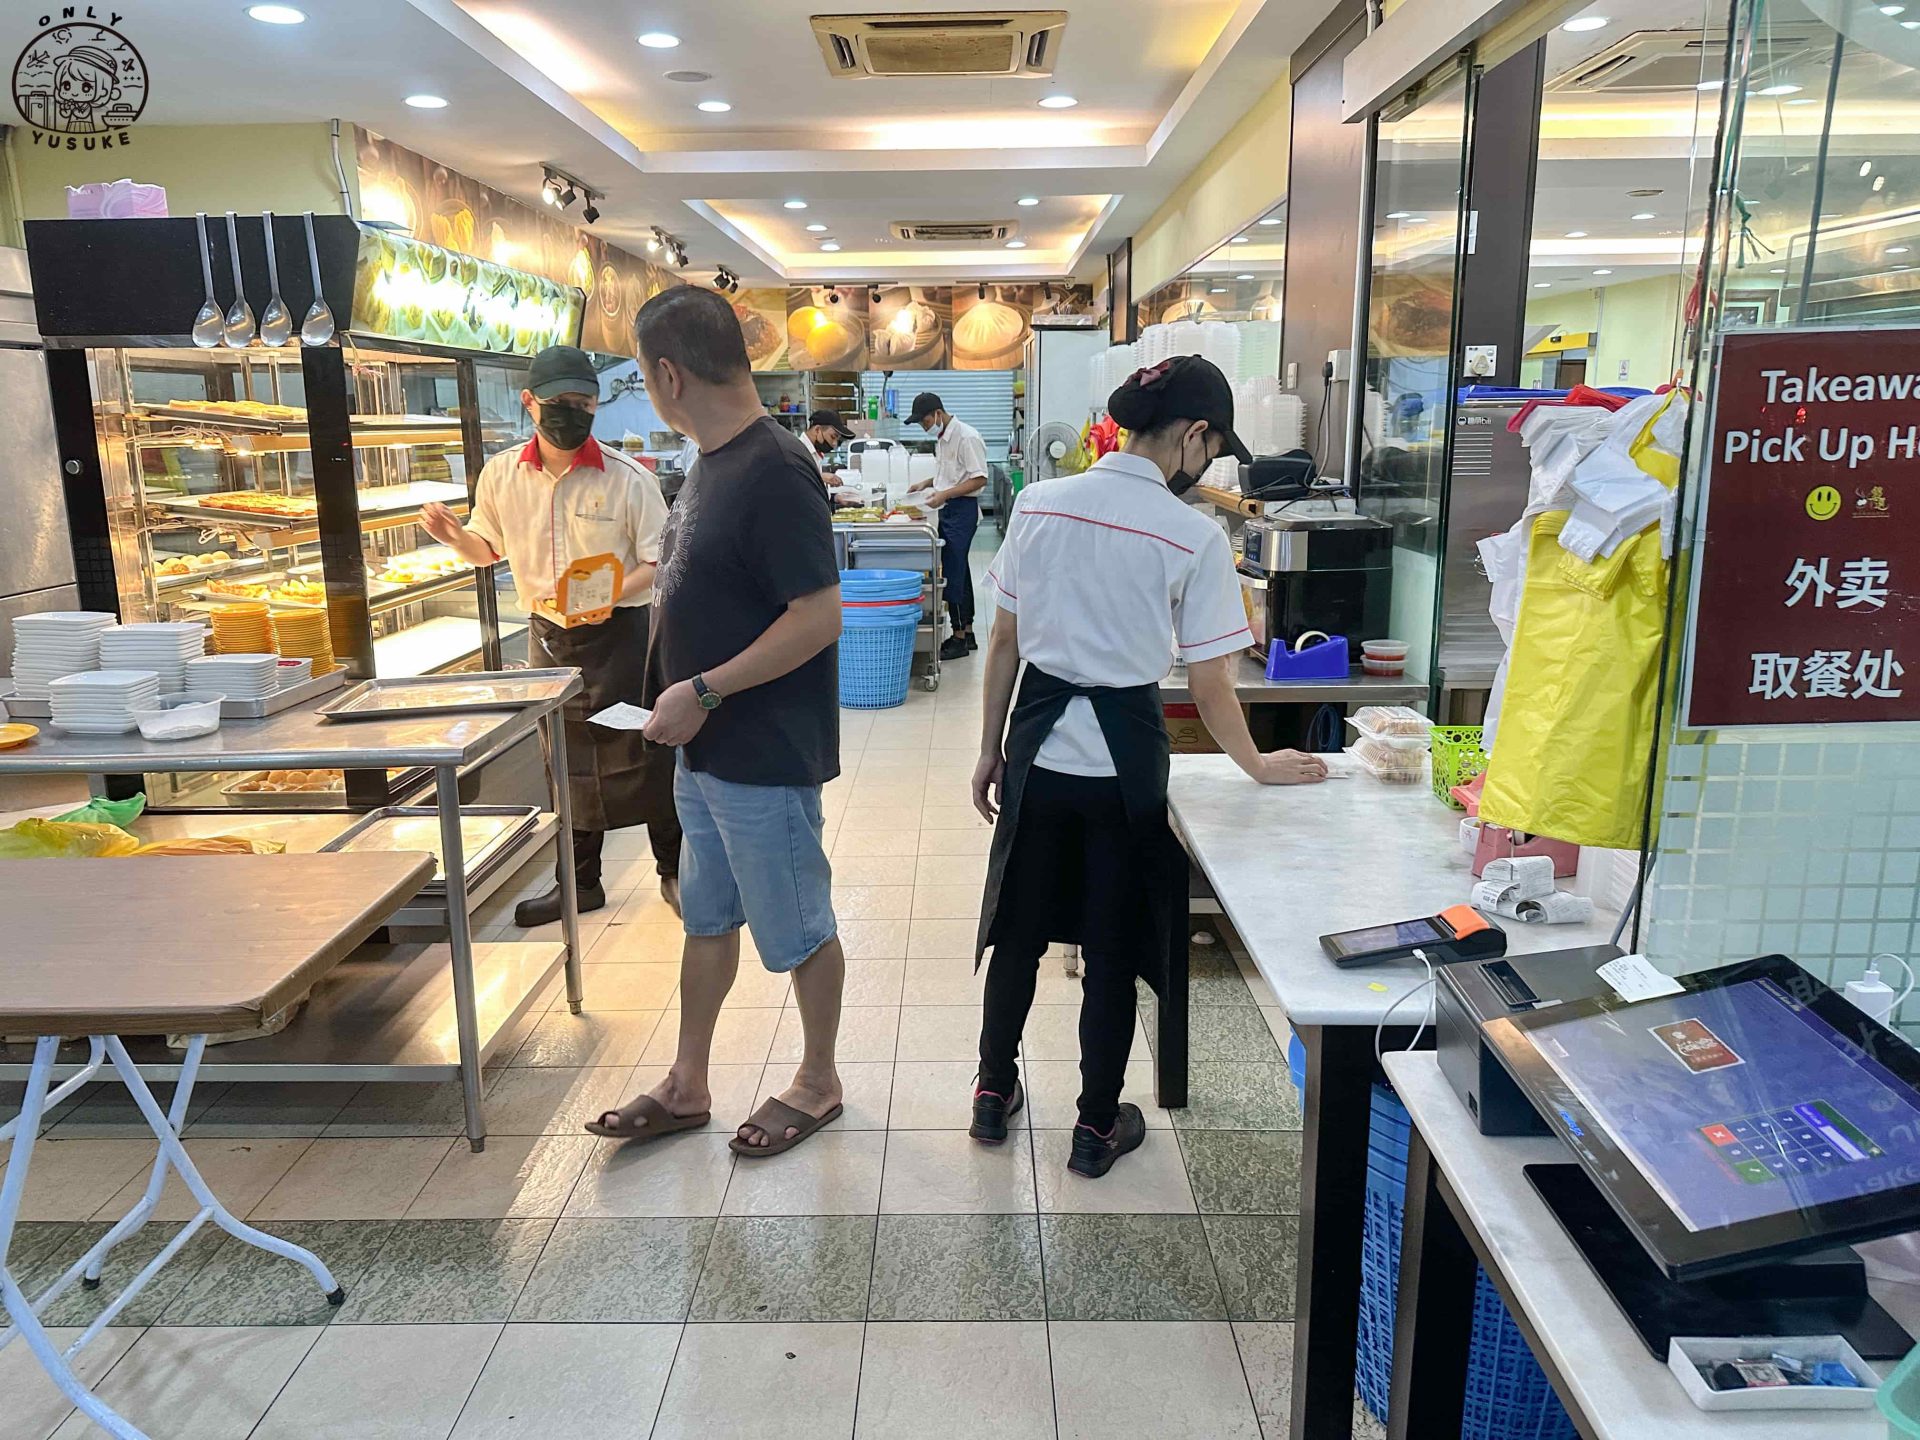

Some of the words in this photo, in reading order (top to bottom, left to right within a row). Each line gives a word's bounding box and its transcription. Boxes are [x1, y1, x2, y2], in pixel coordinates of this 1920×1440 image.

[1724, 427, 1808, 464] Pick
[1819, 428, 1875, 469] Up
[1887, 426, 1920, 460] H
[1784, 557, 1890, 609] 外卖
[1748, 649, 1905, 700] 取餐处
